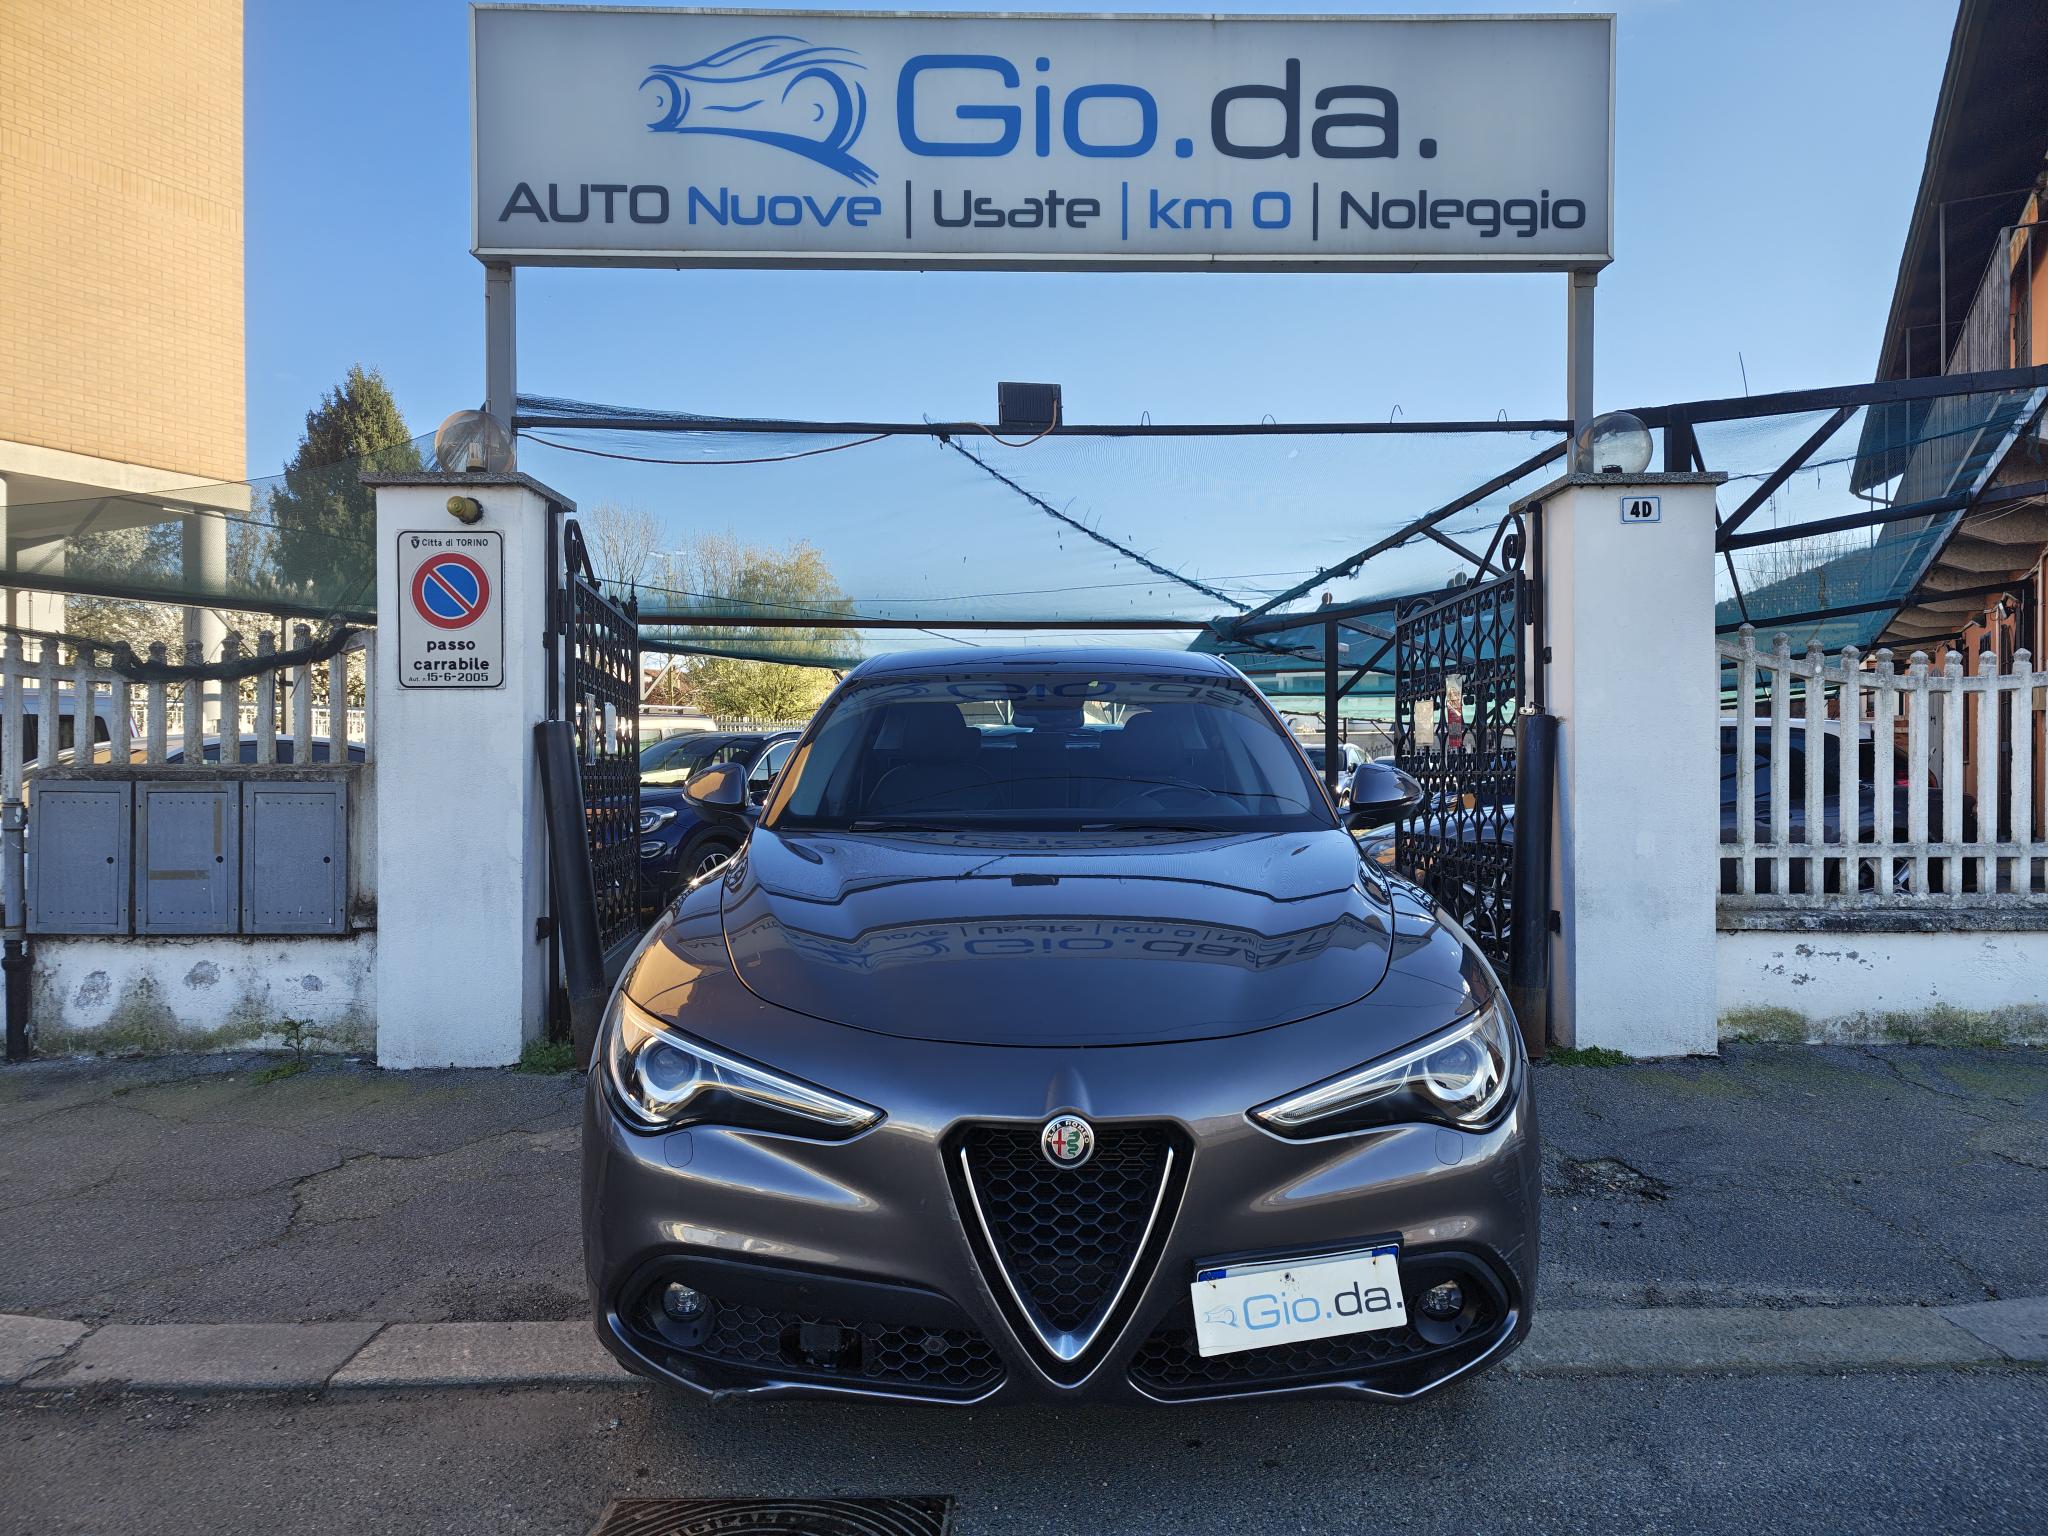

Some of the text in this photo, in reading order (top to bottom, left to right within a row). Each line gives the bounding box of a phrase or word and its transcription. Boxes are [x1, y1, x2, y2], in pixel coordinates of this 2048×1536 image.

[498, 182, 669, 224] AUTO
[688, 186, 882, 228] Nuove
[933, 189, 1101, 229] Usate
[1149, 189, 1233, 229] km
[1340, 189, 1587, 238] Noleggio
[1630, 501, 1652, 518] 4D
[445, 538, 453, 547] di
[456, 538, 489, 547] TORINO
[426, 640, 476, 653] passo
[413, 657, 490, 670] carrabile
[427, 672, 489, 682] 15-6-2005
[1046, 1120, 1090, 1144] ALFA ROMEO
